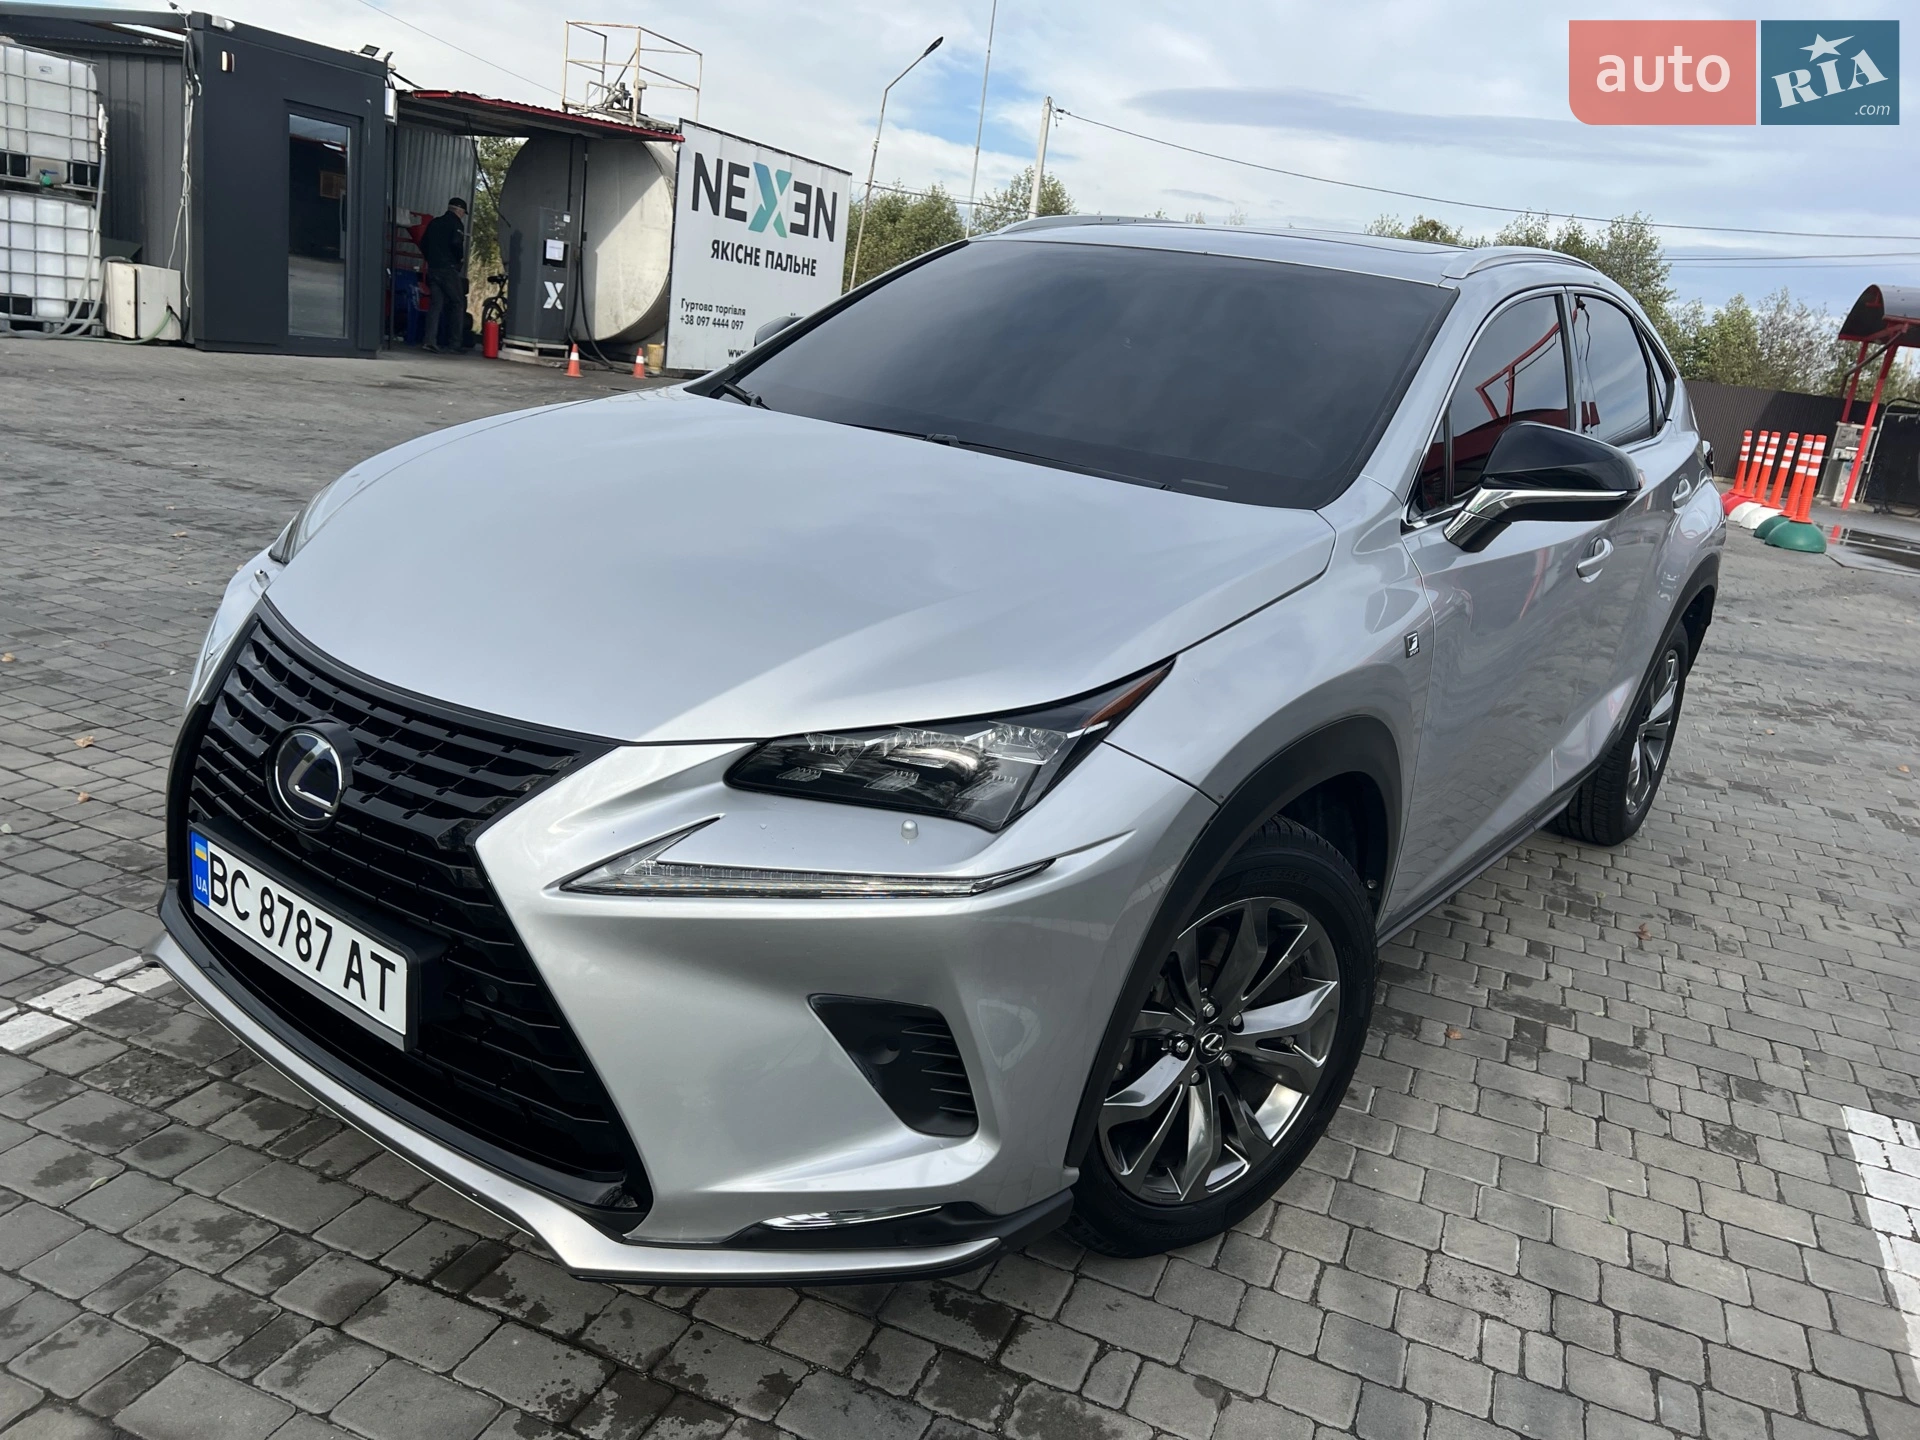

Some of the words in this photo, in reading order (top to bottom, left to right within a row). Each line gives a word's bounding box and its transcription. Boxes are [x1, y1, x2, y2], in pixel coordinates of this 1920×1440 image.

[710, 239, 761, 267] ЯКІСНЕ
[765, 249, 817, 277] ПАЛЬНЕ
[680, 298, 713, 313] Гуртова
[715, 304, 746, 317] торгівля
[680, 314, 694, 326] +38
[696, 316, 710, 328] 097
[712, 317, 730, 330] 4444
[731, 320, 744, 331] 097
[195, 874, 208, 896] UA
[209, 850, 250, 922] BC
[259, 886, 334, 973] 8787
[343, 939, 396, 1012] AT
